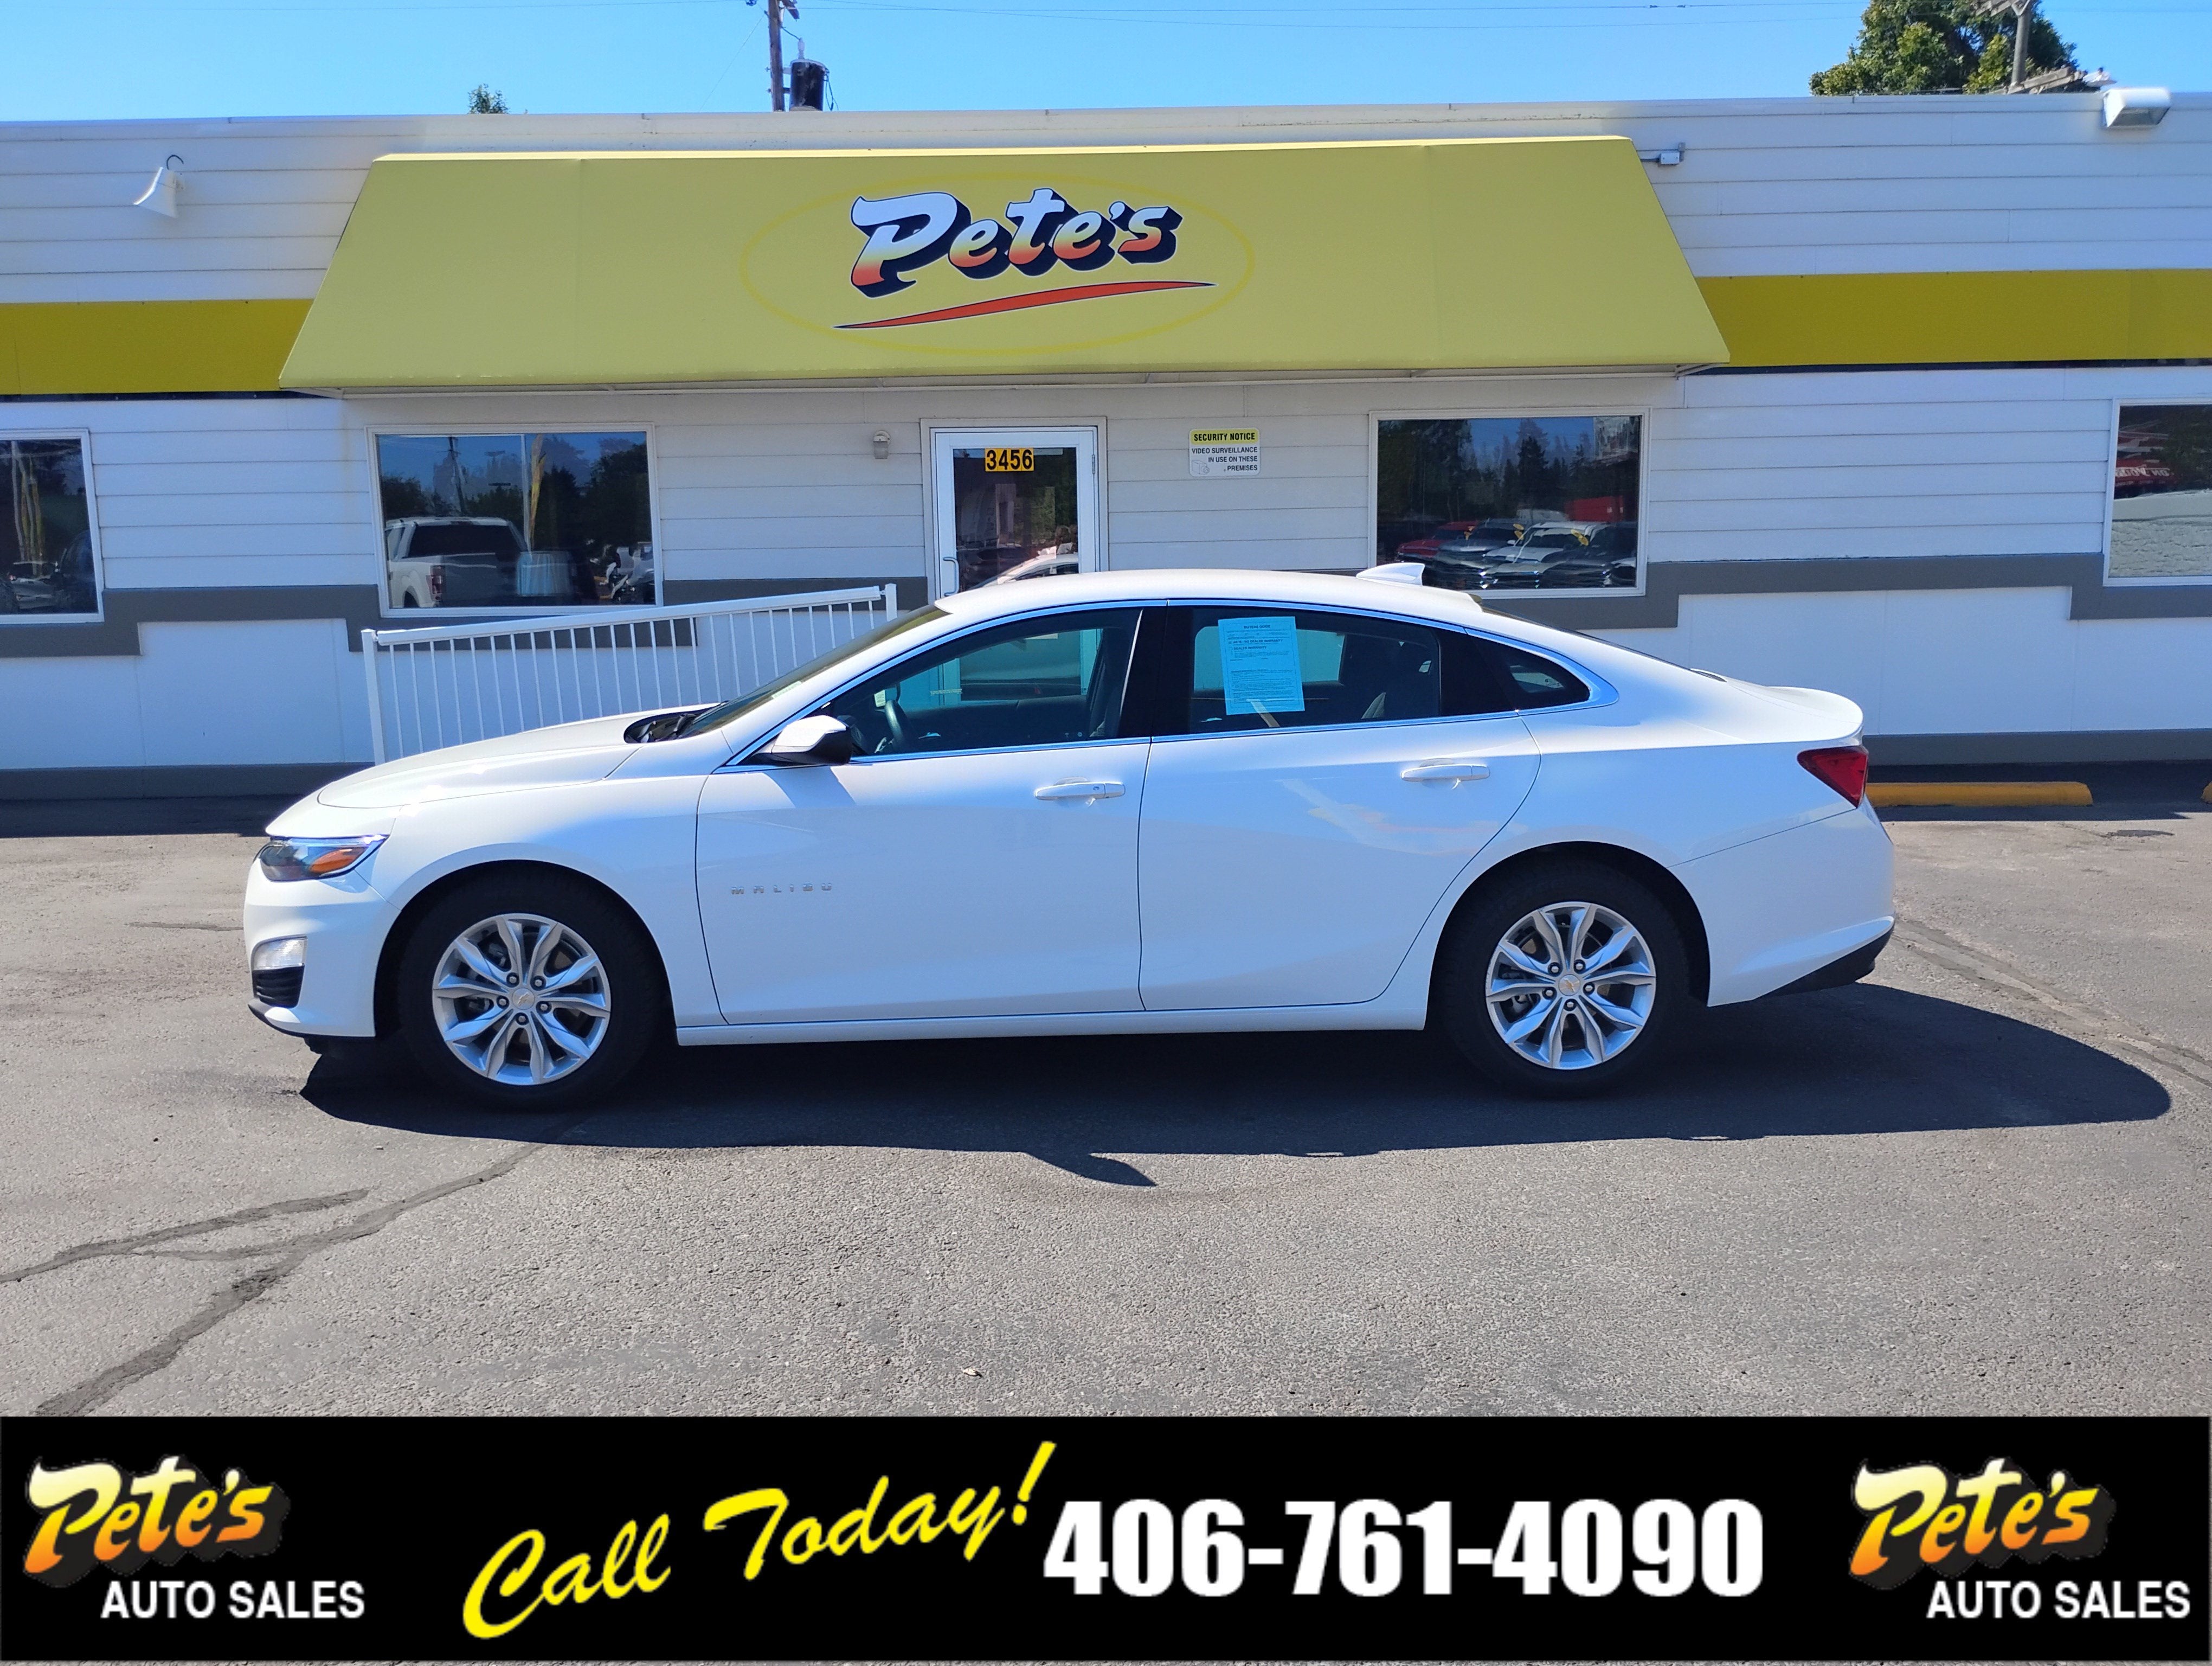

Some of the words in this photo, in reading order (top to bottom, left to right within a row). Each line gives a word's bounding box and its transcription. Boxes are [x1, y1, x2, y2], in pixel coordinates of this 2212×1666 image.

[851, 188, 1182, 298] Pete's
[1194, 433, 1227, 441] SECURITY
[1230, 432, 1255, 440] NOTICE
[986, 449, 1033, 470] 3456
[731, 883, 832, 895] MALIBU
